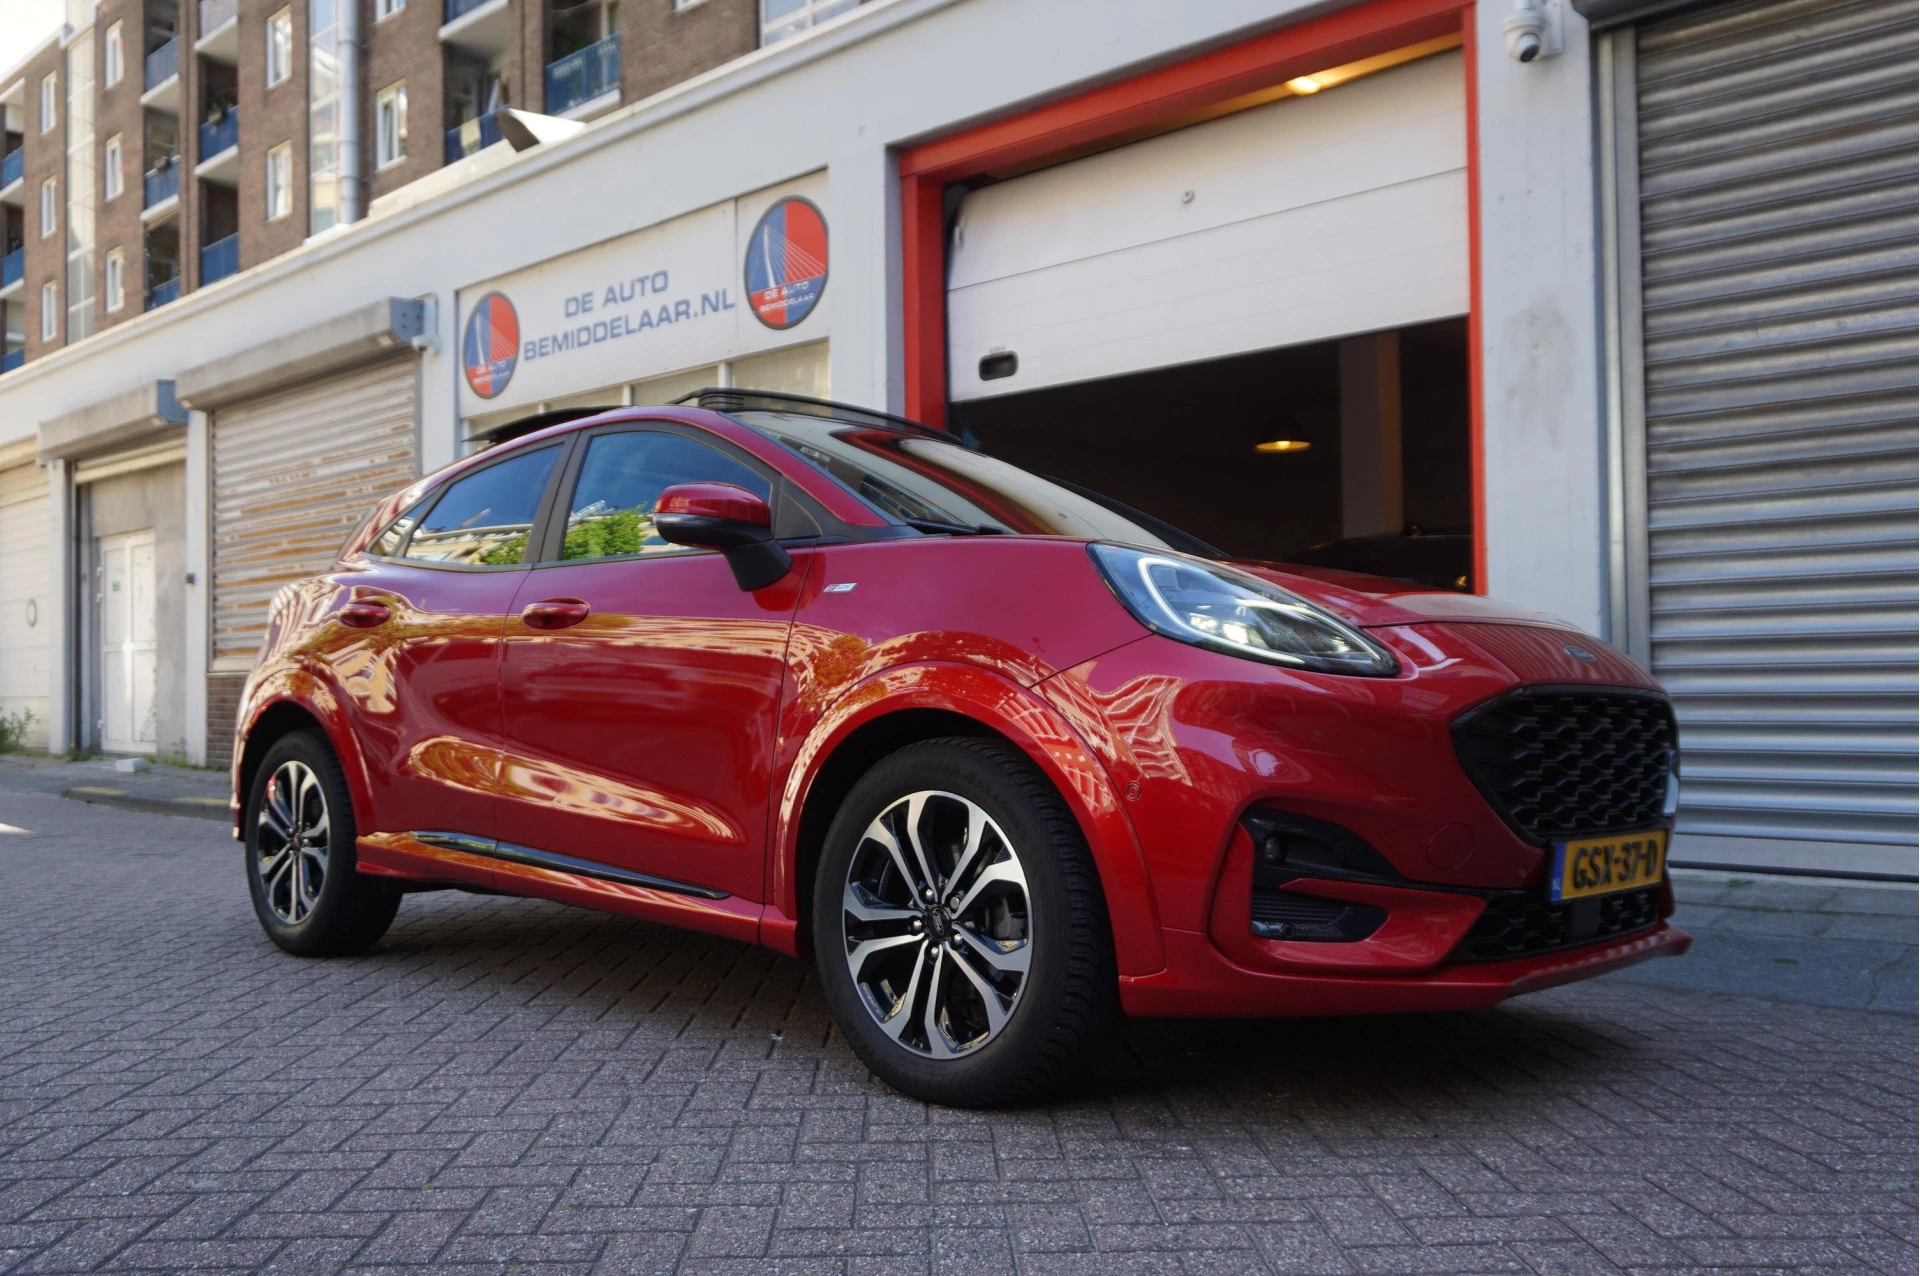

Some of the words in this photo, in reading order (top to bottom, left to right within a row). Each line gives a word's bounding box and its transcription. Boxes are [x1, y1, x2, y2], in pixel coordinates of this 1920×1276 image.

[564, 291, 594, 318] DE
[602, 270, 669, 308] AUTO
[760, 293, 815, 312] BEMIDDELAAR
[764, 288, 778, 300] DE
[781, 281, 809, 296] AUTO
[523, 288, 736, 362] BEMIDDELAAR.NL
[1573, 839, 1658, 889] GSX-37-D
